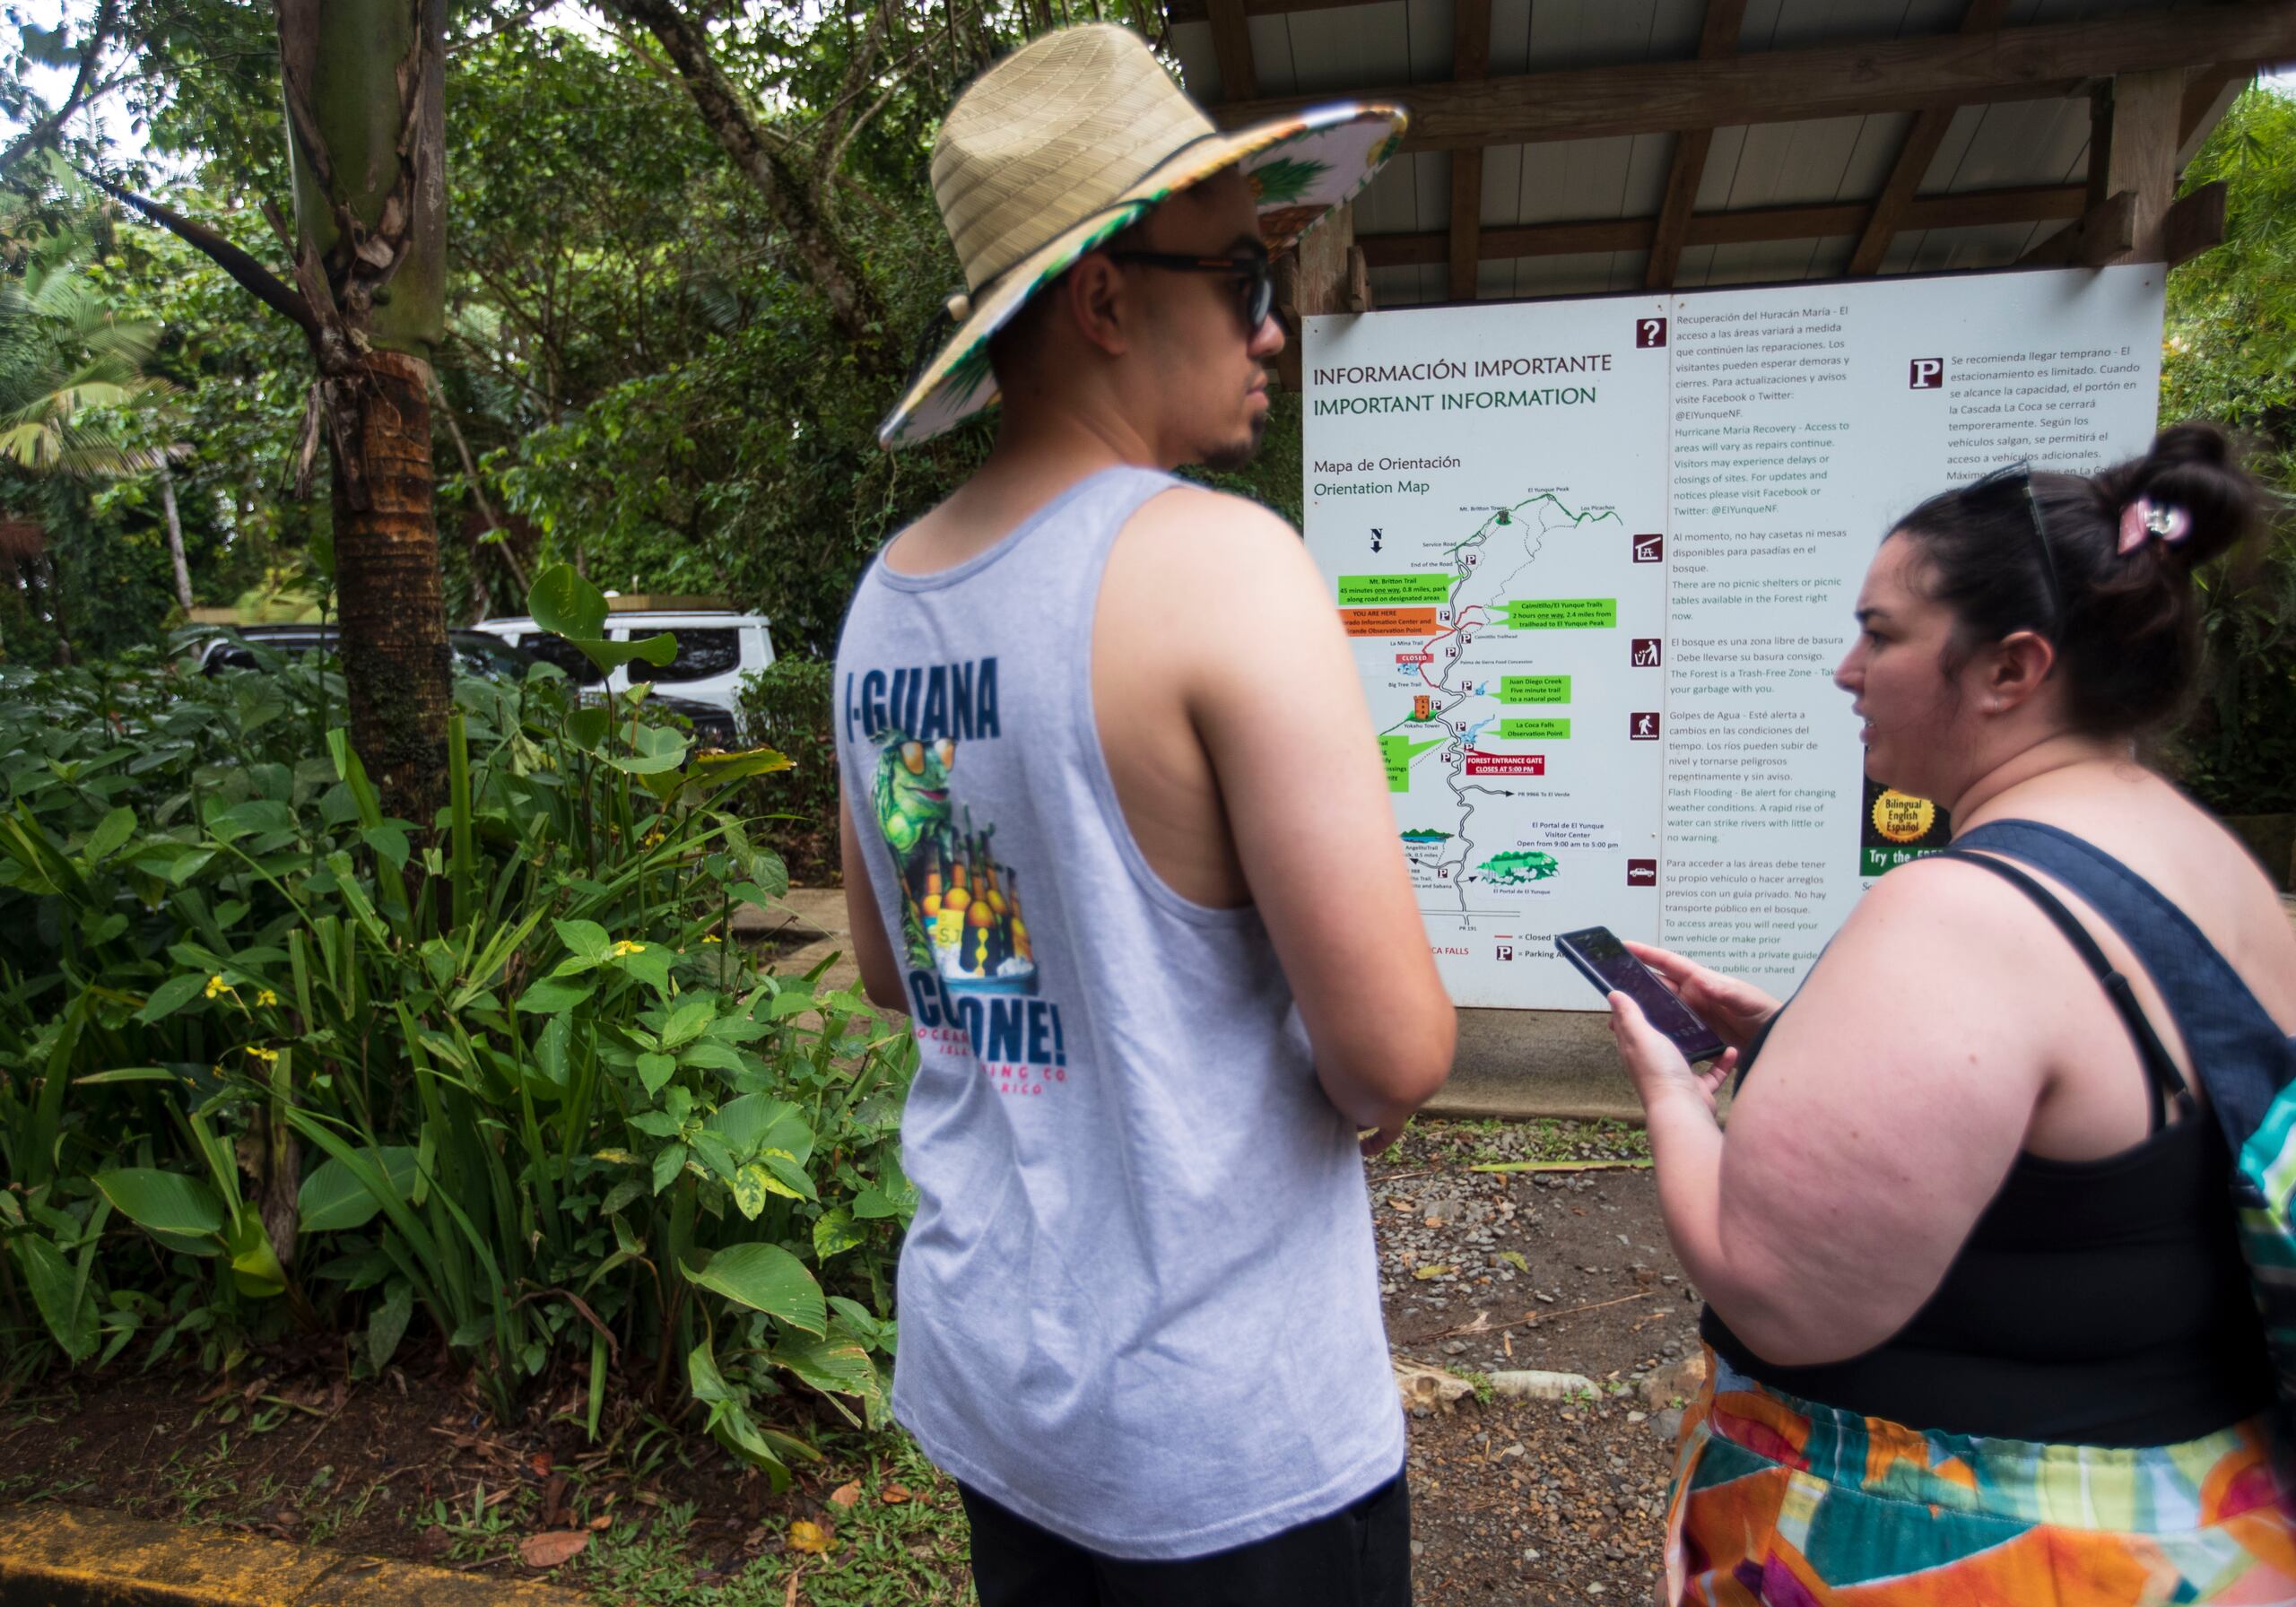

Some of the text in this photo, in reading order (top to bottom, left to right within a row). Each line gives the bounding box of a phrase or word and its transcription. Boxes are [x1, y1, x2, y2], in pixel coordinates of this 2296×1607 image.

[1313, 353, 1611, 385] INFORMACIÓN IMPORTANTE
[1675, 356, 1849, 372] visitantes pueden esperar demoras y
[1950, 362, 2140, 381] estacionamiento es limitado. Cuando
[1314, 387, 1596, 416] IMPORTANT INFORMATION
[1675, 395, 1700, 404] visite
[1701, 393, 1746, 403] Facebook
[1758, 391, 1794, 400] Twitter:
[1948, 416, 2088, 432] temporeramente. Según los
[1948, 437, 1994, 447] vehículos
[1996, 436, 2031, 447] salgan,
[2048, 432, 2096, 445] permitirá
[2098, 432, 2108, 441] el
[1314, 456, 1460, 475] Mapa de Orientación
[1674, 458, 1709, 468] Visitors
[1710, 460, 1730, 468] may
[1733, 457, 1784, 467] experience
[1787, 455, 1817, 465] delays
[1314, 480, 1430, 496] Orientation Map
[1674, 491, 1707, 499] notices
[1709, 490, 1739, 499] please
[1742, 489, 1761, 498] visit
[1762, 487, 1808, 497] Facebook
[1370, 528, 1383, 540] N
[1672, 580, 1699, 588] There
[1733, 580, 1760, 588] picnic
[1761, 578, 1799, 586] shelters
[1813, 578, 1841, 587] picnic
[1670, 684, 1773, 695] your garbage with you.
[1668, 757, 1691, 765] nivel
[1740, 757, 1787, 767] peligrosos
[1707, 804, 1755, 812] conditions.
[1769, 804, 1793, 813] rapid
[1813, 804, 1824, 812] of
[1885, 798, 1922, 812] Bilingual
[1888, 811, 1918, 823] English
[1887, 821, 1919, 834] Español
[1869, 849, 1887, 868] Try
[1892, 849, 1910, 863] the
[1665, 904, 1712, 913] transporte
[1714, 904, 1748, 914] público
[1763, 905, 1772, 913] el
[1774, 905, 1809, 915] bosque.
[1446, 947, 1469, 955] FALLS
[1525, 951, 1554, 959] Parking
